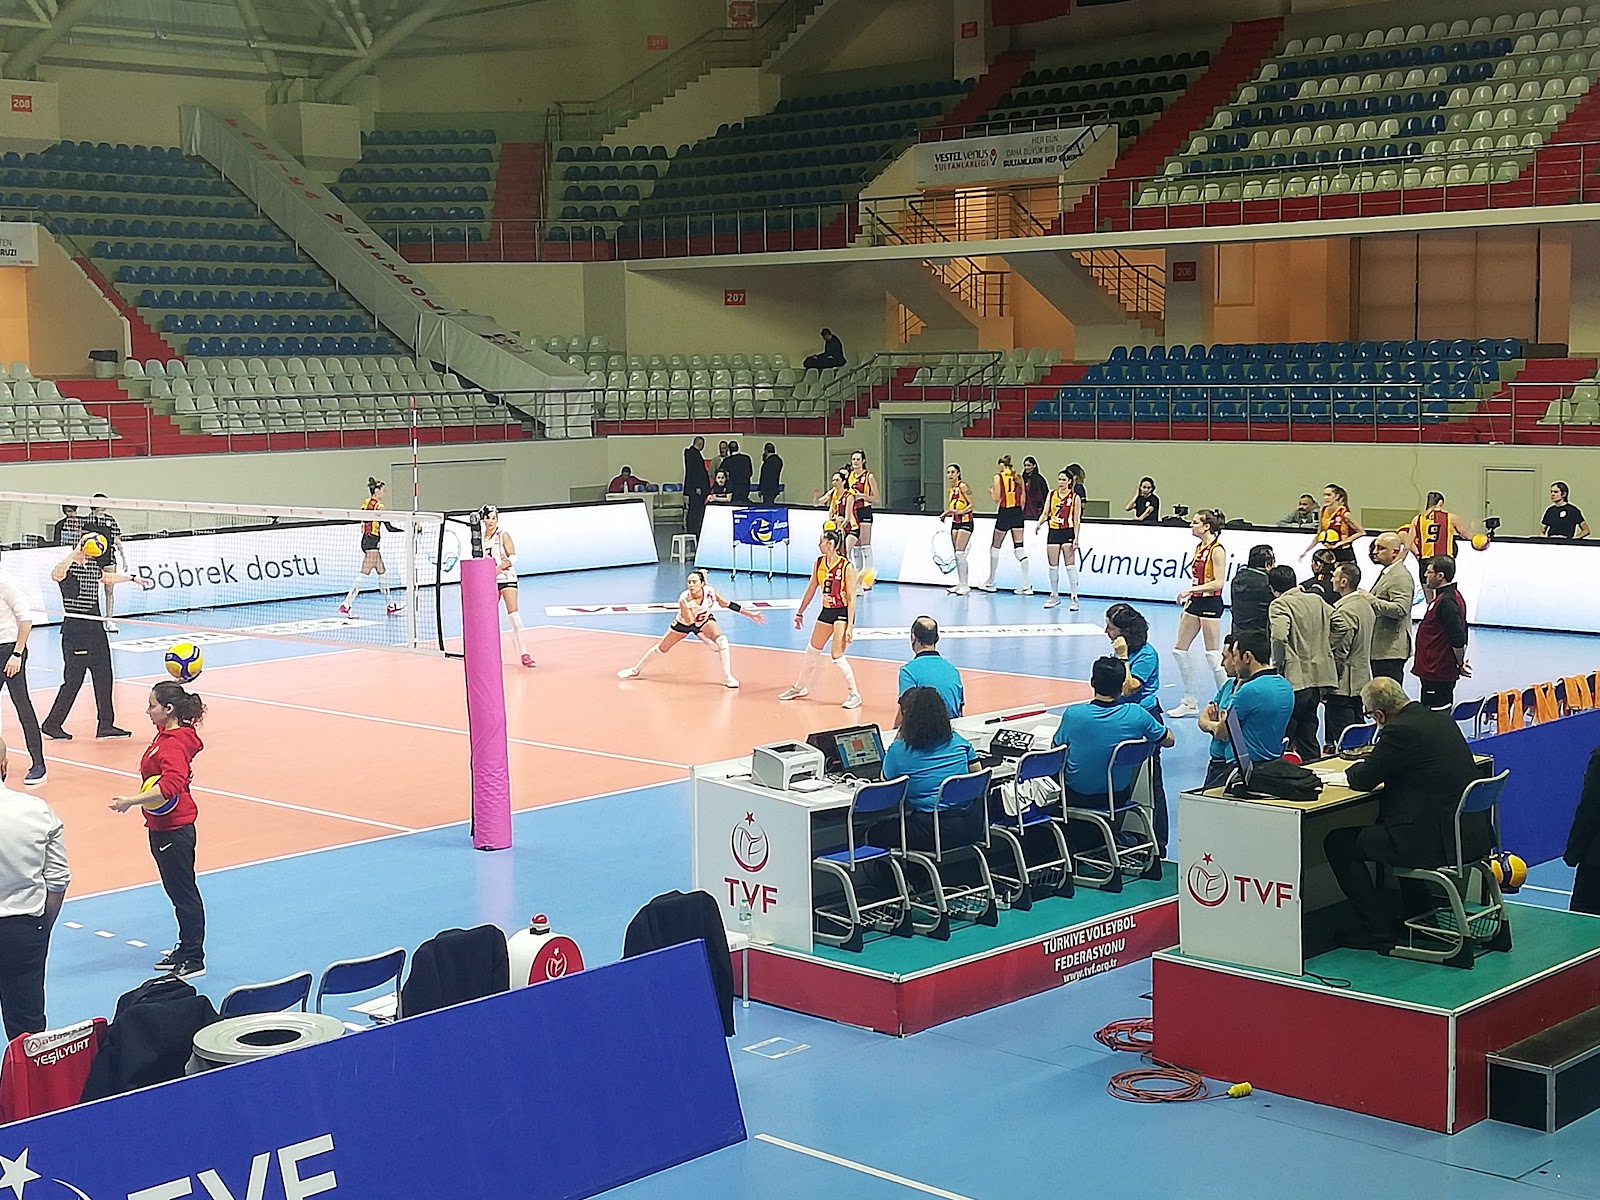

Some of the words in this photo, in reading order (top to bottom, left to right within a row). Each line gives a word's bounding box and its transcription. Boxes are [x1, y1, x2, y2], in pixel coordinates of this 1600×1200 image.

[935, 152, 962, 162] VESTEL
[325, 212, 447, 311] VOLEYBOL
[726, 293, 745, 302] 207
[1426, 524, 1441, 542] 9
[138, 556, 238, 592] Böbrek
[247, 554, 320, 582] dostu
[1077, 547, 1193, 585] Yumuşak
[724, 877, 778, 913] TVF
[1233, 875, 1293, 908] TVF
[1086, 915, 1136, 942] VOLEYBOL
[1055, 938, 1126, 972] FEDERASYONU
[1063, 958, 1118, 983] www.tvf.org.tr
[33, 1038, 90, 1067] YEŞİLYURT
